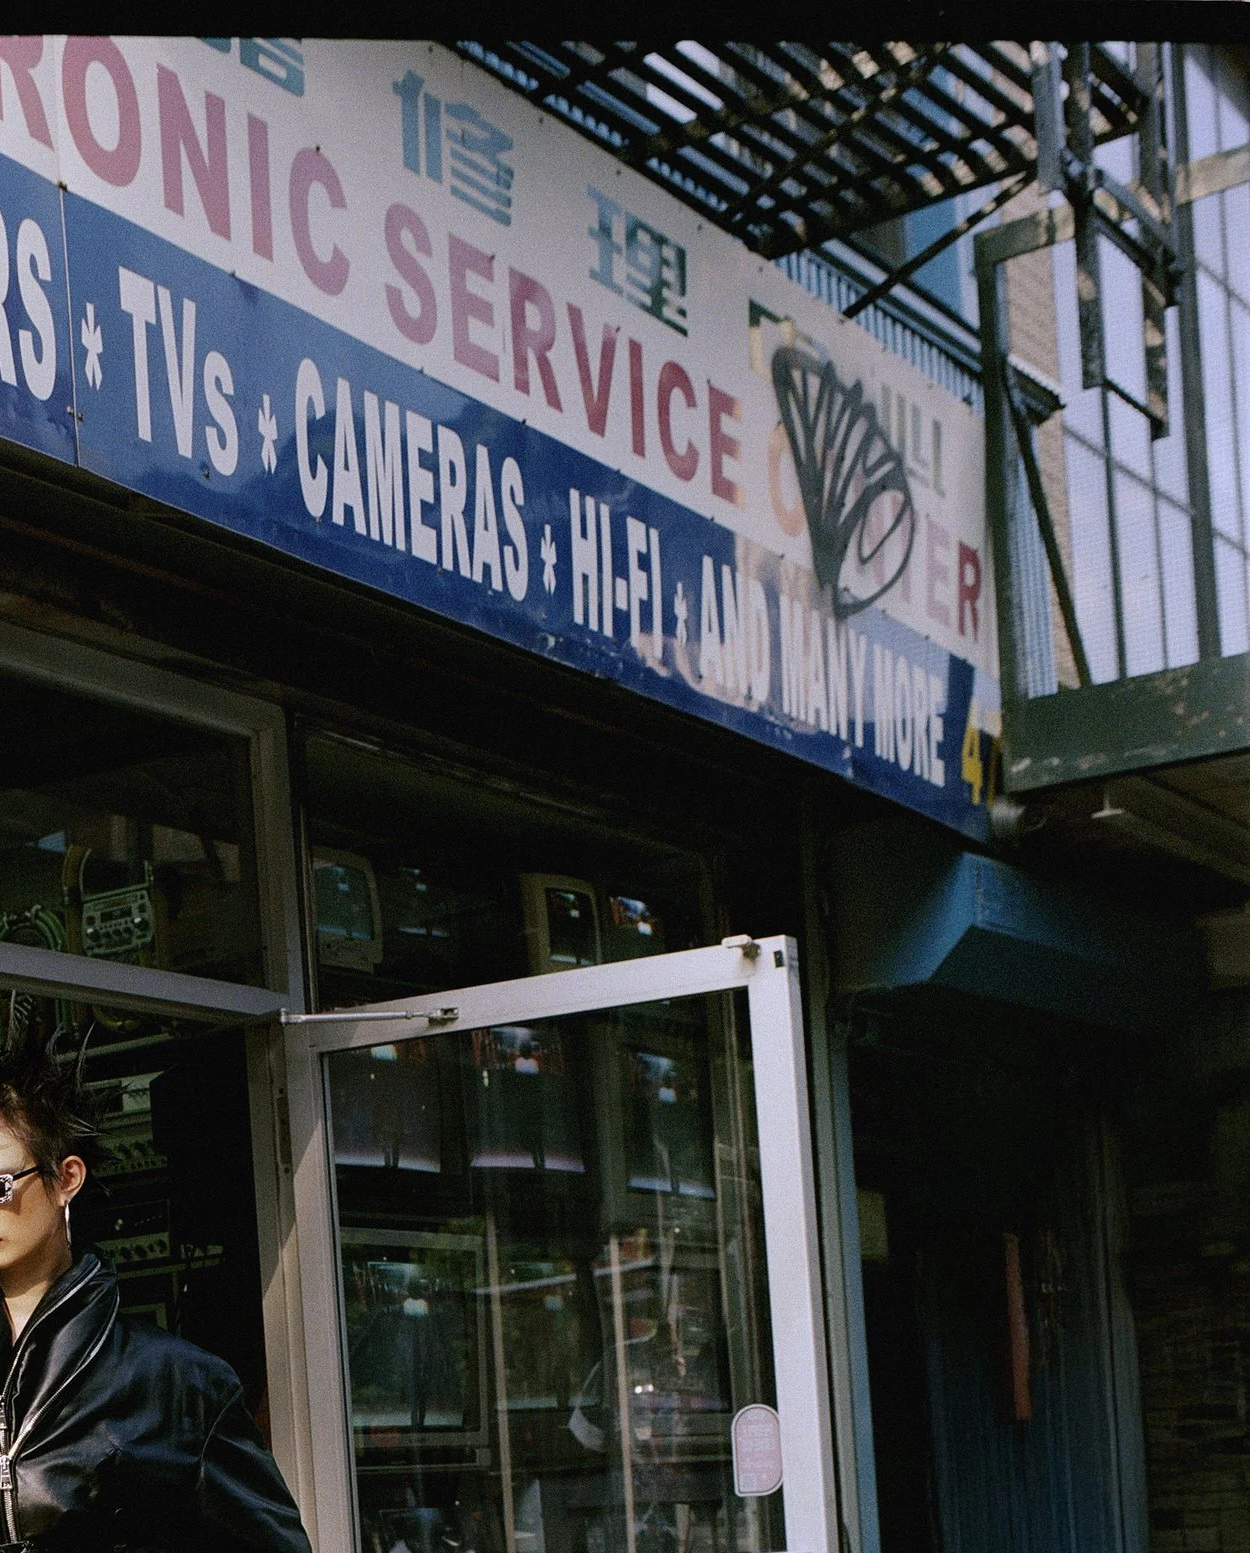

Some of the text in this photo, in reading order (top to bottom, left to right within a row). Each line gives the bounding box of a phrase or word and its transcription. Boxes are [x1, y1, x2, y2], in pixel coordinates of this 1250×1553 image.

[119, 266, 238, 477] TVs
[295, 358, 529, 601] CAMERAS
[570, 487, 664, 669] HI-FI
[699, 555, 770, 701] AND
[780, 593, 866, 749] MANY
[874, 643, 946, 787] MORE
[384, 203, 743, 503] SERVICE
